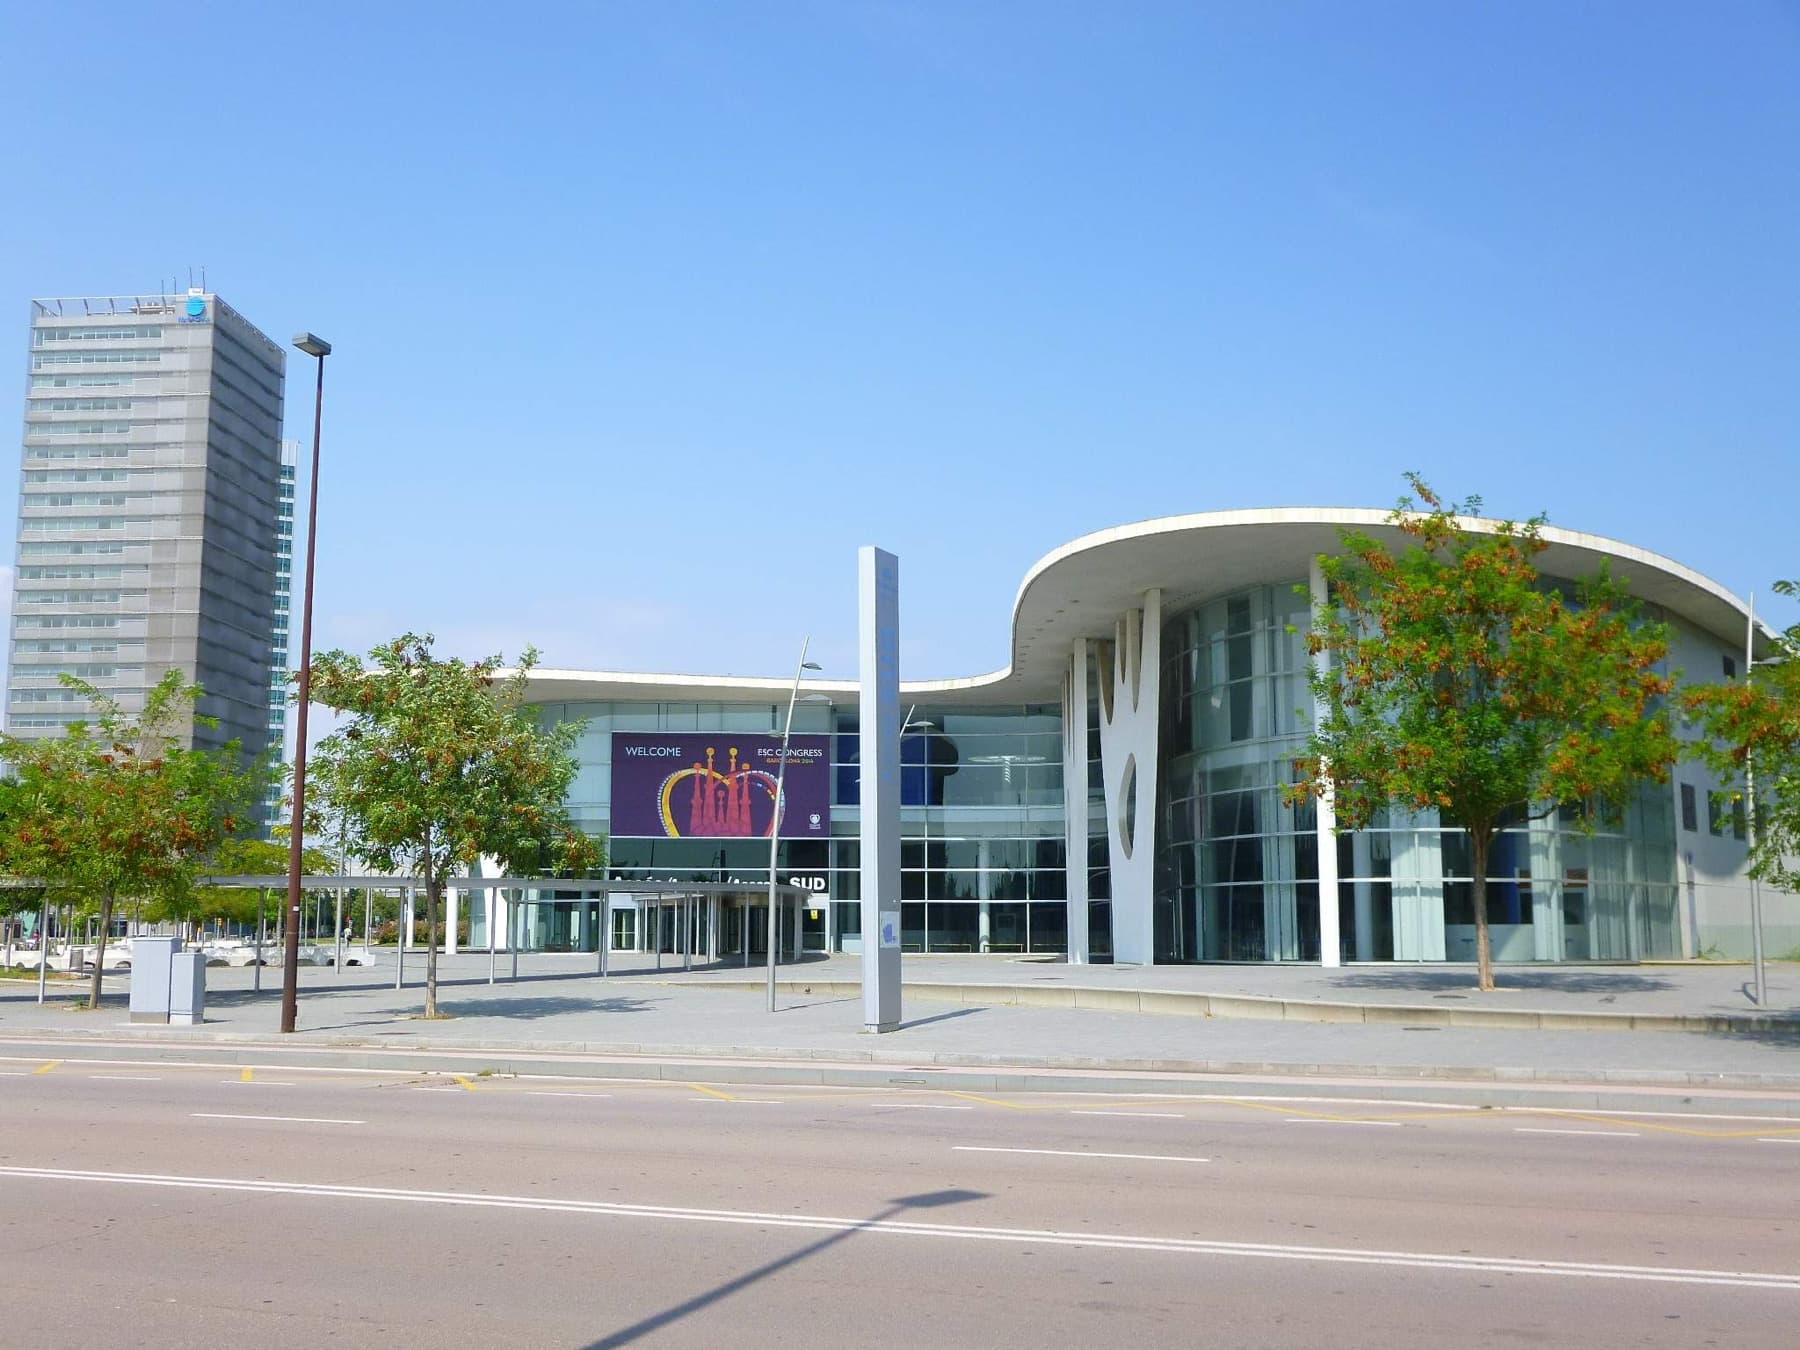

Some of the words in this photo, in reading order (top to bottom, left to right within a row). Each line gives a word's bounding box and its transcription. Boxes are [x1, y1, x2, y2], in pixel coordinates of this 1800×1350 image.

[625, 747, 682, 757] WELCOME
[757, 748, 774, 756] ESC
[789, 877, 826, 890] SUD
